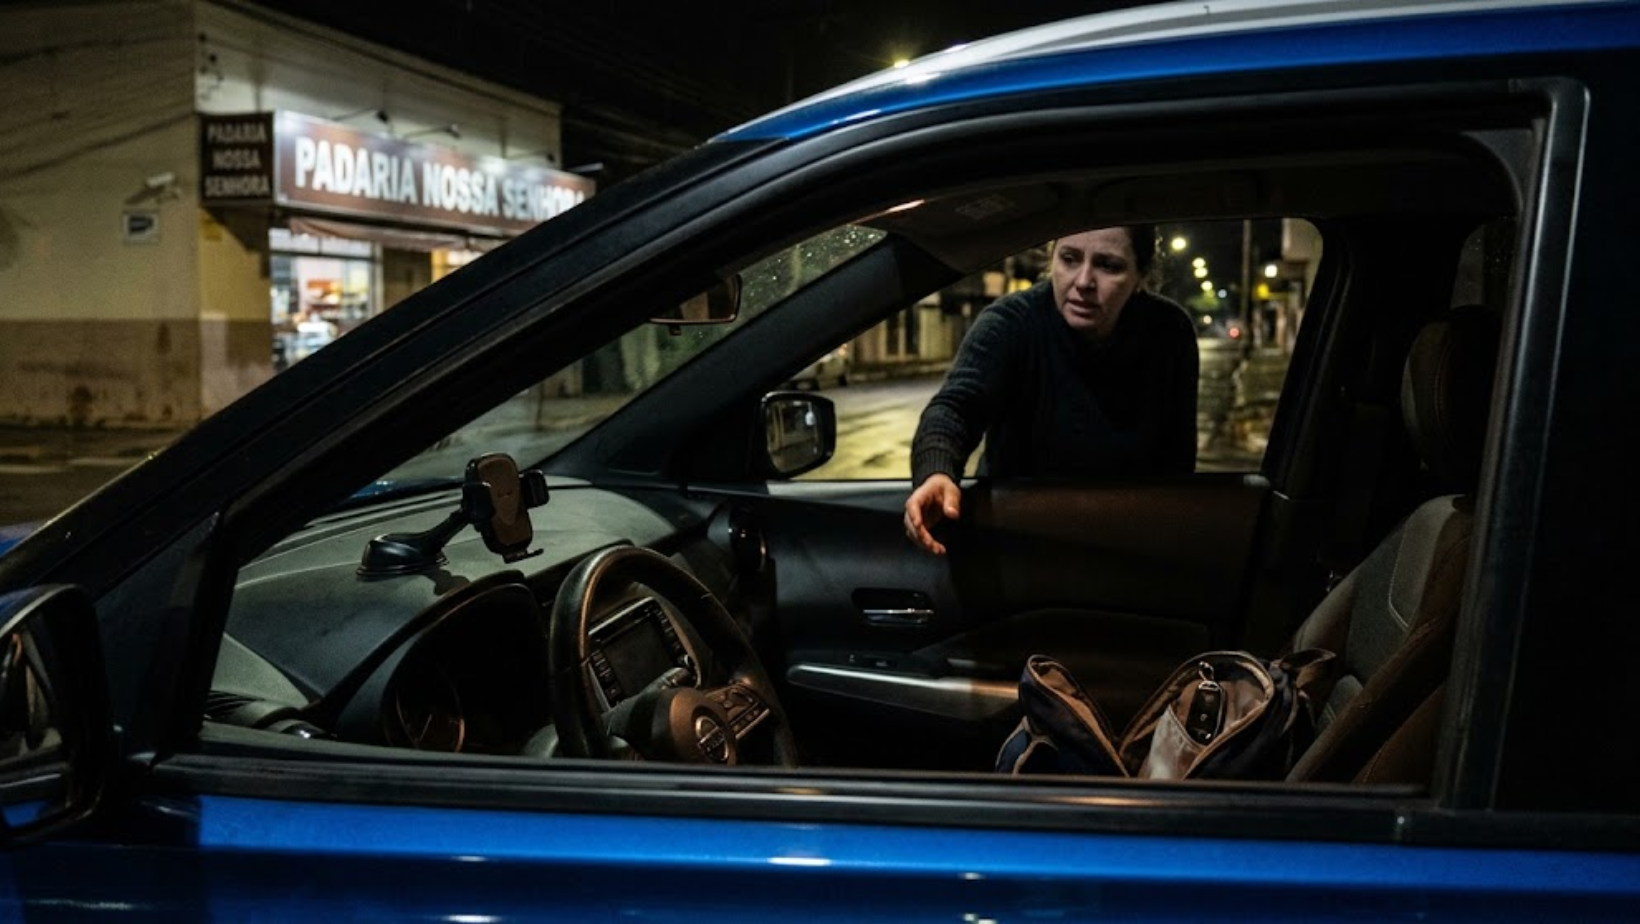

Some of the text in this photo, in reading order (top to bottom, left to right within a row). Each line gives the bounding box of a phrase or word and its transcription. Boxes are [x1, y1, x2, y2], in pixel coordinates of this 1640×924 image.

[208, 123, 267, 143] PADARIA
[212, 149, 261, 170] NOSSA
[205, 175, 270, 197] SENHORA
[295, 136, 418, 205] PADARIA
[422, 161, 499, 216] NOSSA
